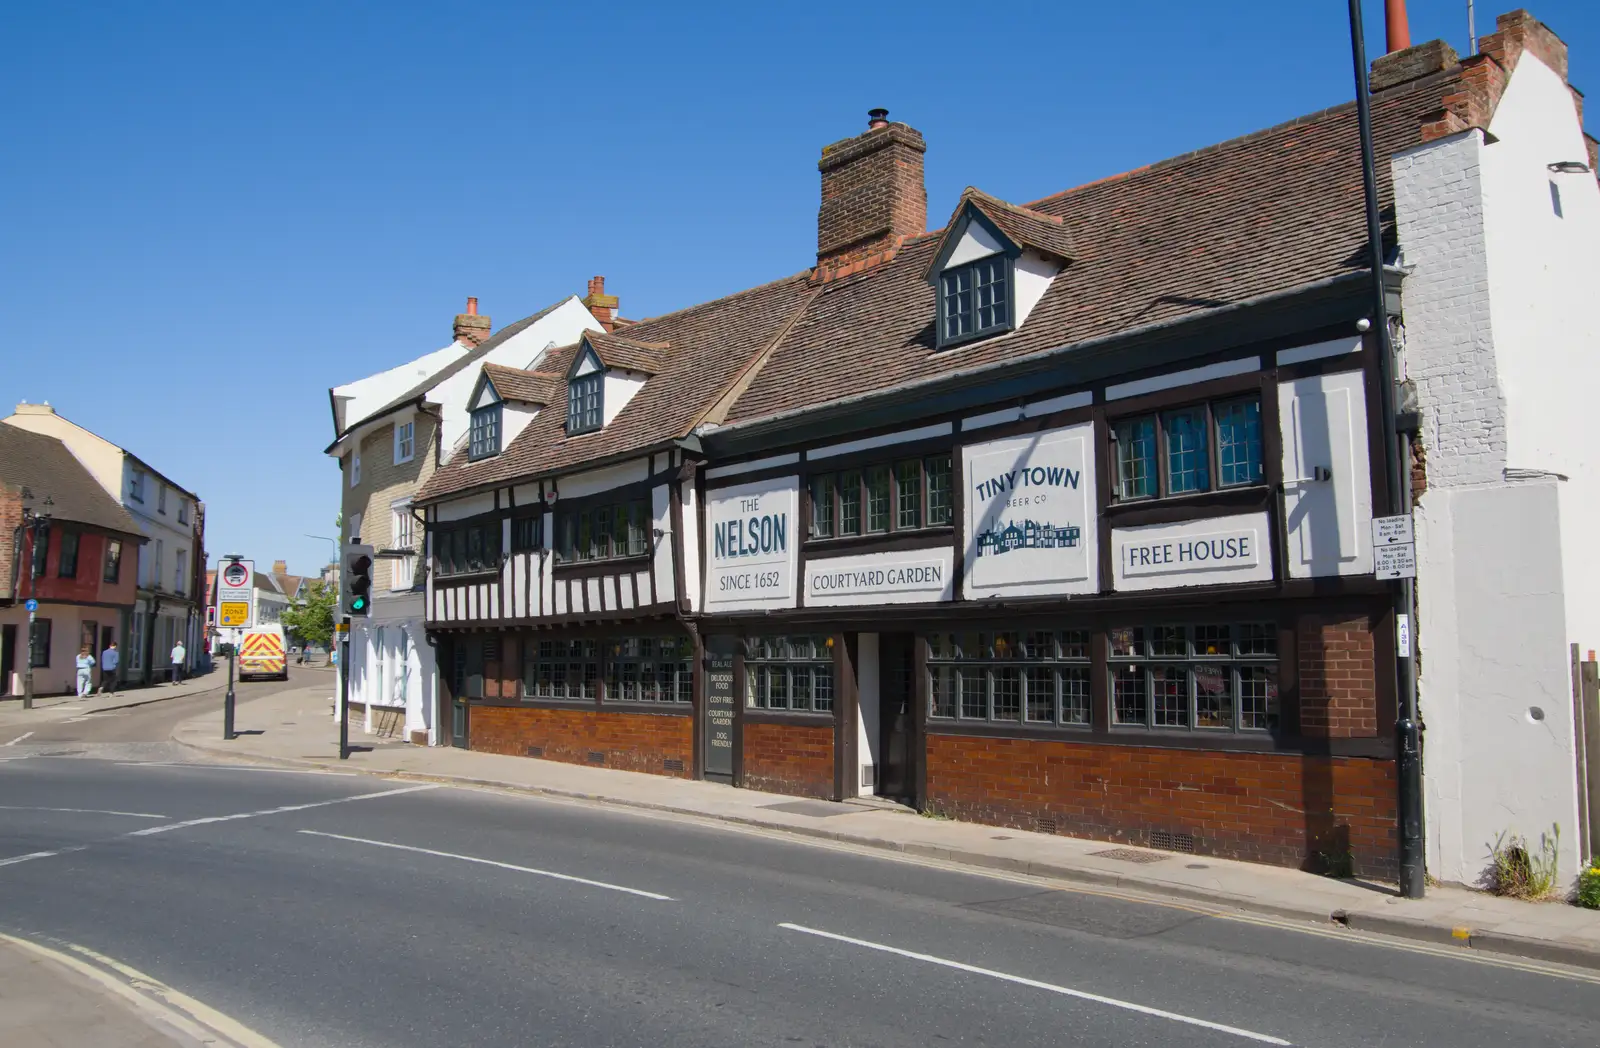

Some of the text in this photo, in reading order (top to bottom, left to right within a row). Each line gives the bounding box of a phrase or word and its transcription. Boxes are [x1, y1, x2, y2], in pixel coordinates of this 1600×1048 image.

[976, 466, 1080, 501] TINY TOWN
[740, 498, 759, 513] THE
[1006, 494, 1047, 508] BEER CO
[714, 513, 787, 559] NELSON
[1130, 537, 1250, 566] FREE HOUSE
[720, 571, 779, 591] SINCE 1652
[813, 566, 941, 590] COURTYARD GARDEN
[708, 710, 736, 718] COURTYARD
[712, 739, 732, 748] FRIENDLY
